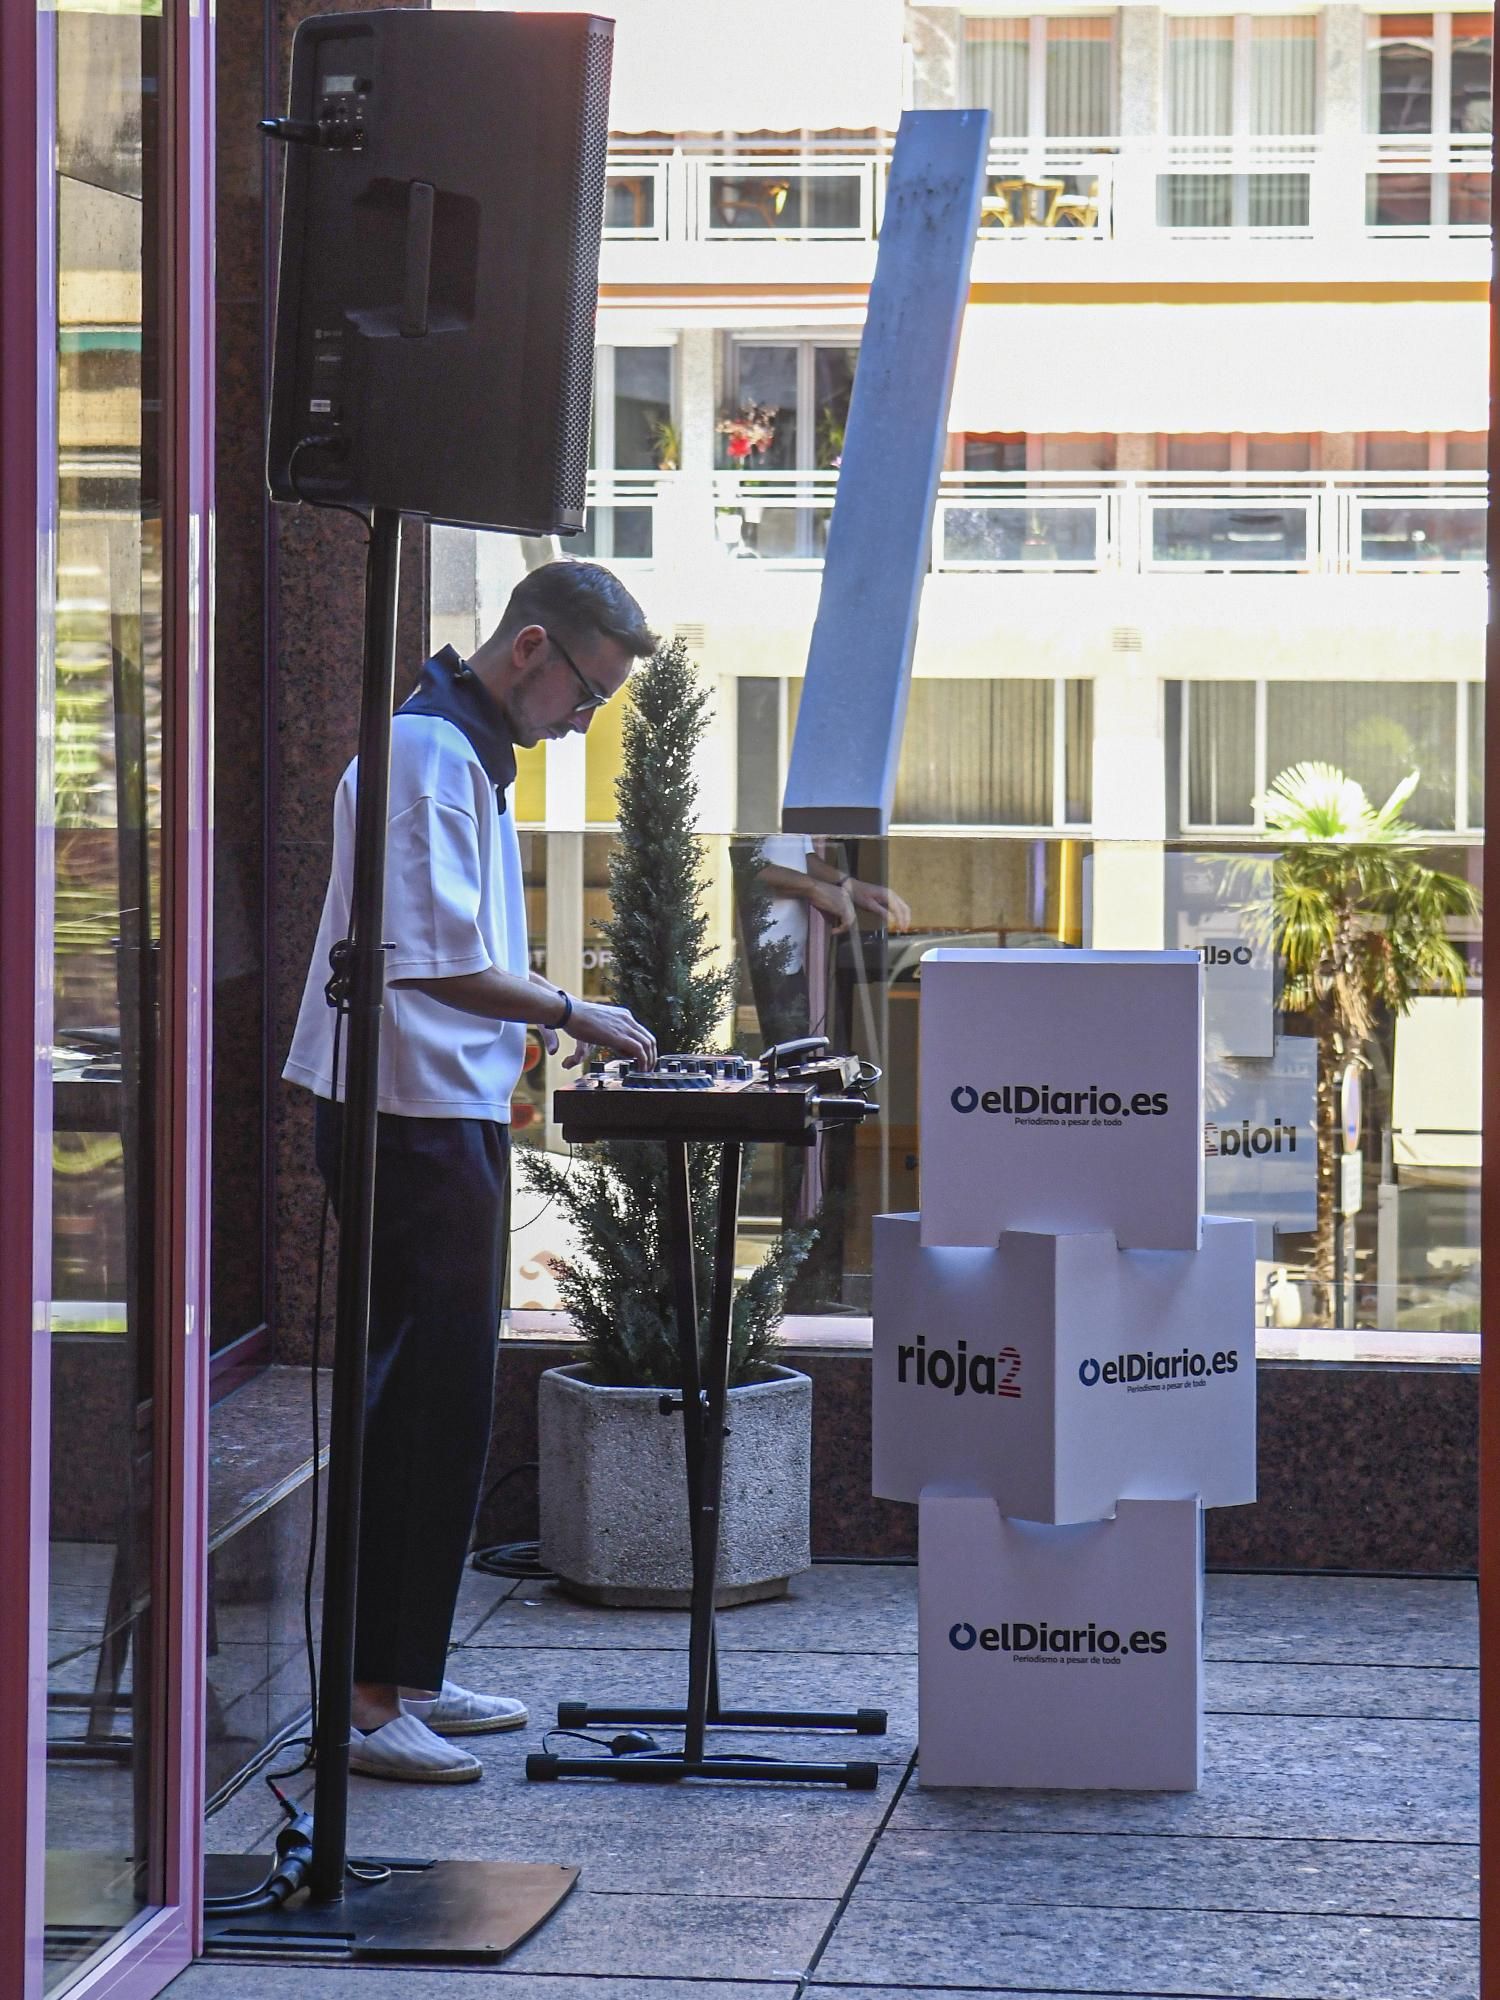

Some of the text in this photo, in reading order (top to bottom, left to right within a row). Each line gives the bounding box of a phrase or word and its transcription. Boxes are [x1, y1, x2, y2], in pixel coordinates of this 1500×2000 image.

[981, 1084, 1168, 1117] elDiario.es
[1015, 1117, 1060, 1126] Periodismo
[1068, 1119, 1090, 1127] pesar
[1091, 1118, 1102, 1126] de
[1103, 1118, 1122, 1127] todo
[898, 1335, 1022, 1398] rioja2
[1102, 1348, 1238, 1384] elDiario.es
[1127, 1384, 1160, 1393] Periodismo
[1167, 1382, 1183, 1391] pesar
[979, 1622, 1167, 1655] elDiario.es
[1013, 1655, 1058, 1663] Periodismo
[1067, 1657, 1088, 1665] pesar
[1090, 1656, 1100, 1664] de
[1102, 1656, 1121, 1665] todo
